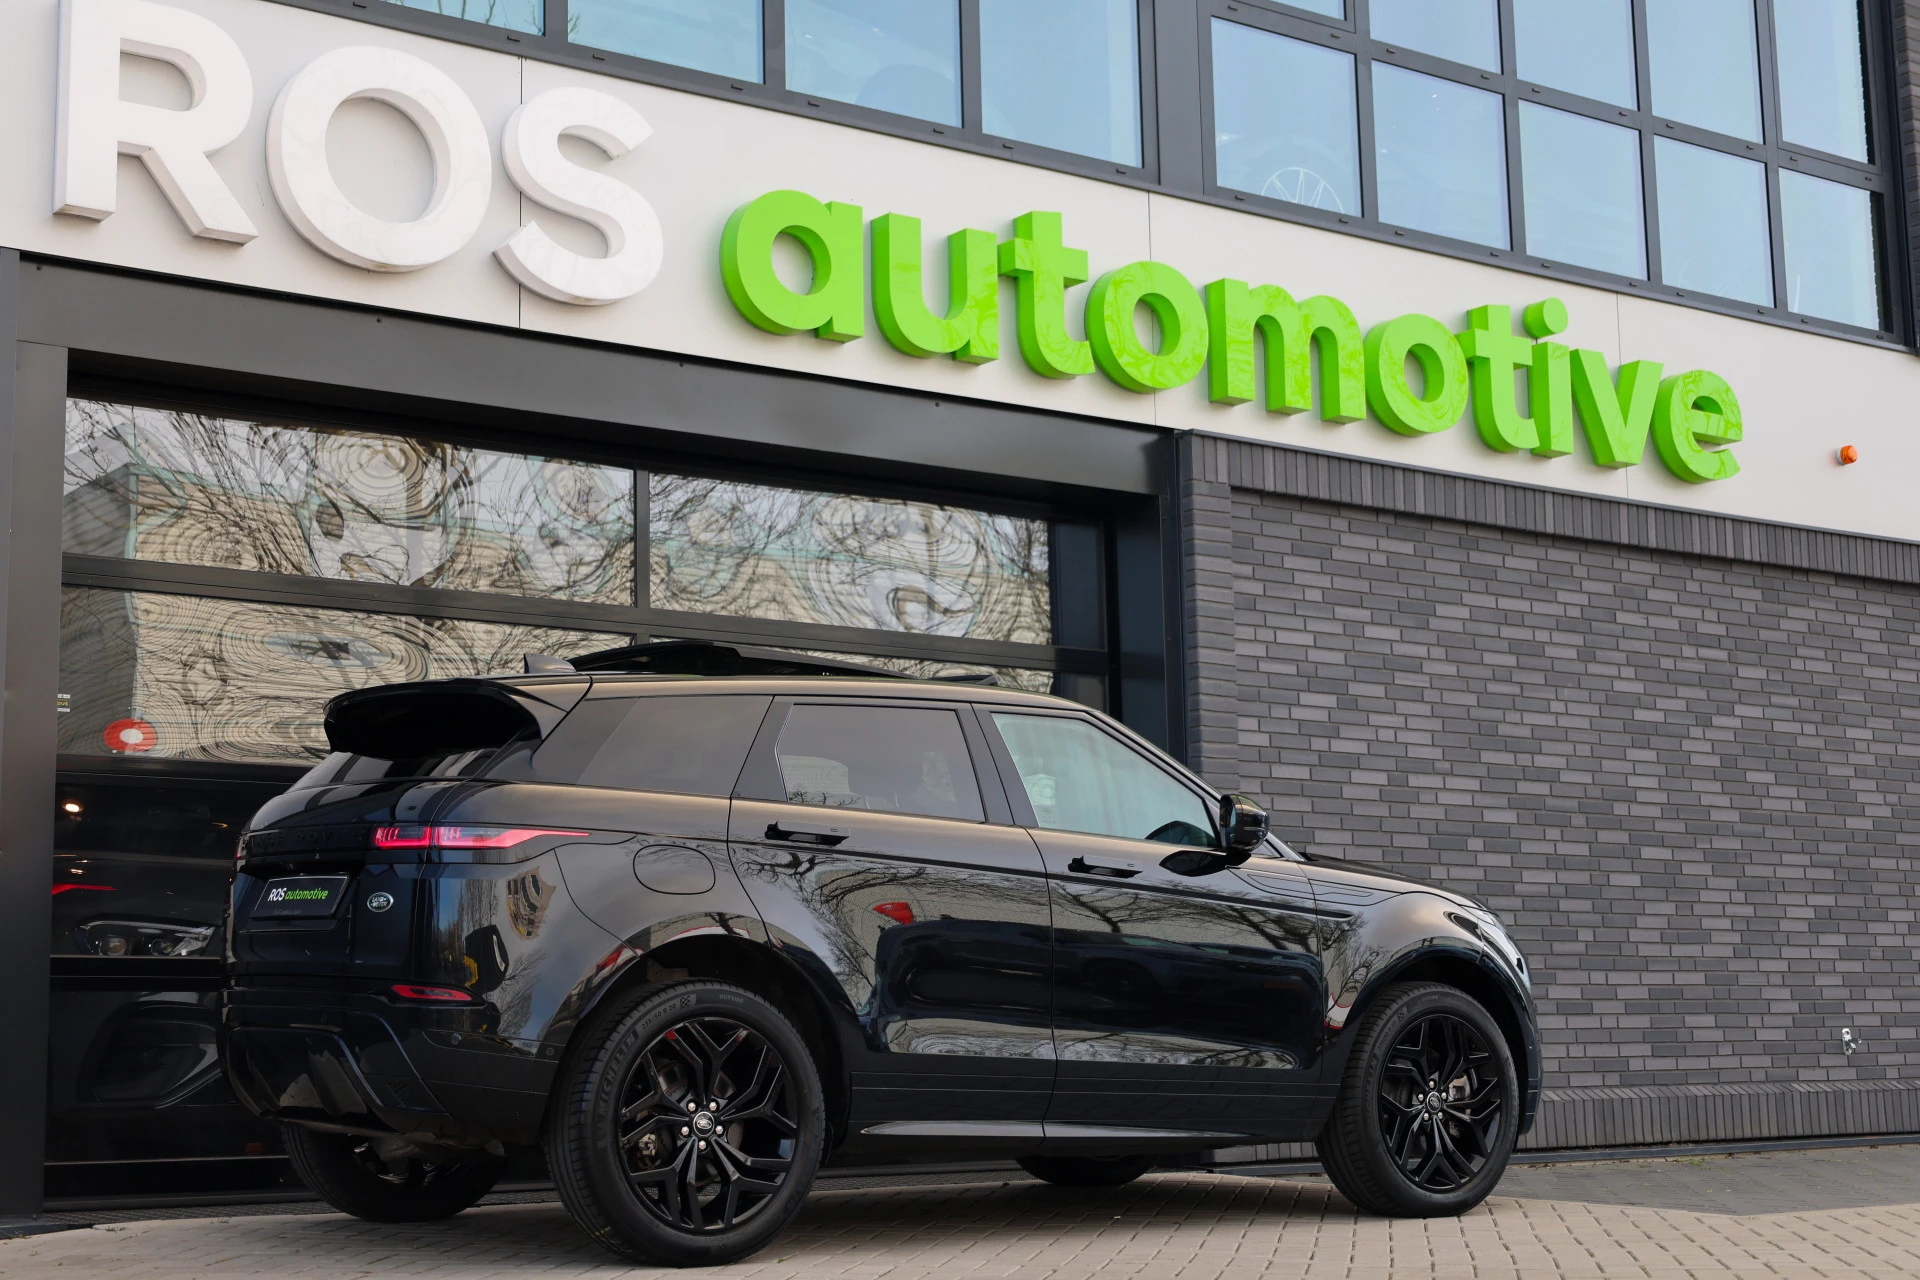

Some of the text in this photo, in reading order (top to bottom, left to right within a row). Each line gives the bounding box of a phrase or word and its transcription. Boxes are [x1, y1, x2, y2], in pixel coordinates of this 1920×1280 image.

[52, 0, 1743, 484] ROS automotive
[267, 887, 329, 902] ROS automotive
[597, 1030, 637, 1118] MICHELIN
